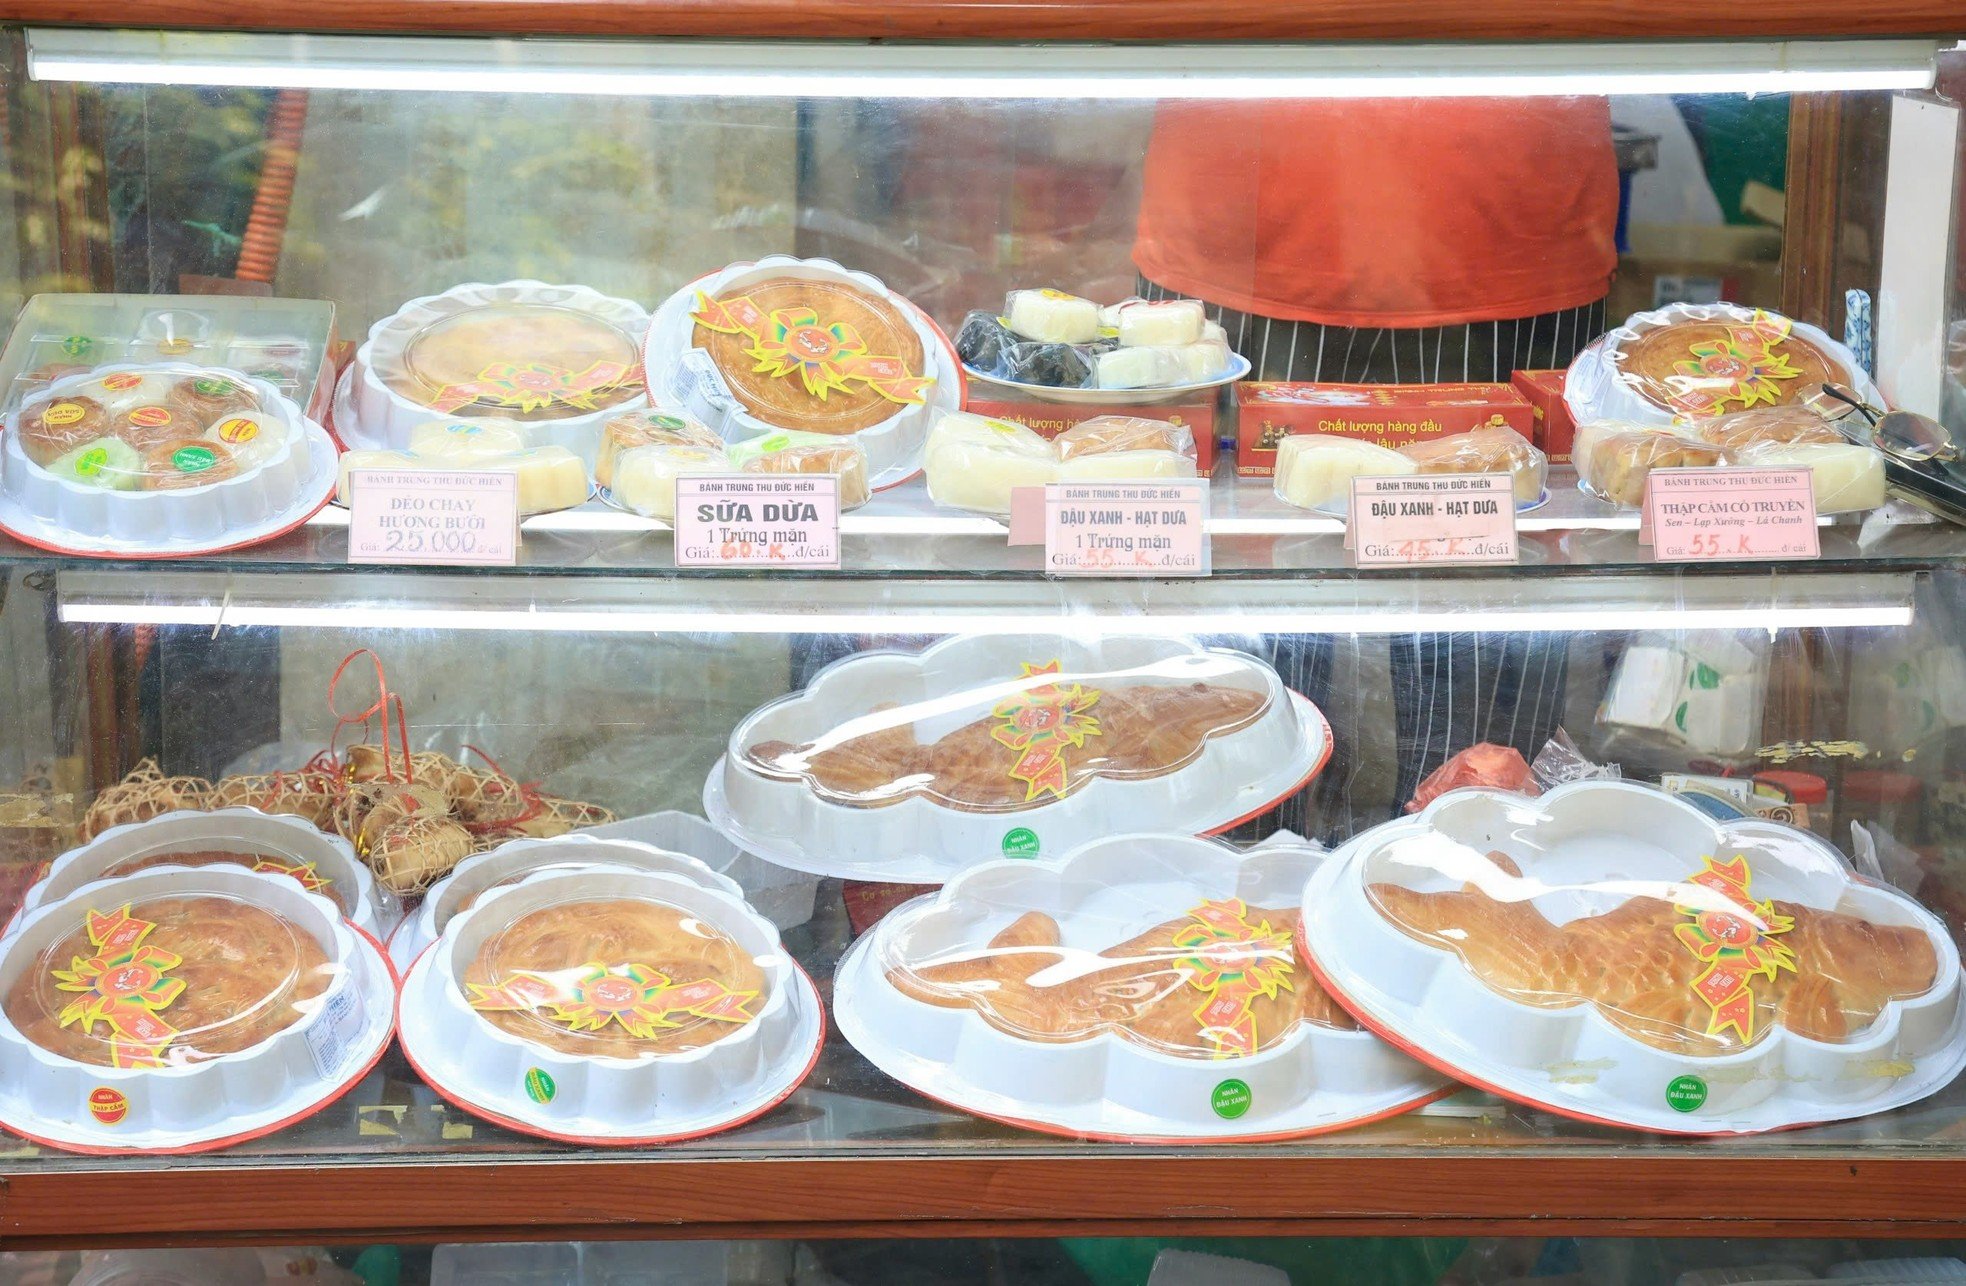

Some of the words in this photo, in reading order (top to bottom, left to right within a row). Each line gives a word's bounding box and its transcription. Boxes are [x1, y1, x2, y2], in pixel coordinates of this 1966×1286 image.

[1318, 417, 1346, 432] Chất
[1350, 420, 1384, 434] lượng
[1388, 420, 1417, 434] hàng
[1420, 418, 1442, 432] đầu
[397, 476, 430, 485] TRUNG
[433, 477, 452, 485] THU
[699, 481, 723, 492] BÁNH
[726, 483, 754, 492] TRUNG
[756, 483, 772, 492] THU
[774, 480, 792, 491] ĐỨC
[1376, 481, 1400, 491] BÁNH
[1402, 481, 1430, 490] TRUNG
[1433, 481, 1448, 490] THU
[1451, 479, 1468, 489] ĐỨC
[1693, 478, 1726, 486] TRUNG
[1729, 477, 1747, 485] THU
[1066, 489, 1089, 498] BÁNH
[1092, 490, 1120, 498] TRUNG
[1123, 490, 1138, 499] THU
[1141, 488, 1158, 499] ĐỨC
[429, 498, 475, 511] CHAY
[697, 499, 753, 523] SỮA
[763, 499, 819, 522] DỪA
[1371, 500, 1396, 519] ĐẬU
[1400, 502, 1434, 516] XANH
[1446, 501, 1469, 518] HẠT
[1473, 499, 1498, 514] DƯA
[1661, 502, 1696, 516] THẬP
[1730, 499, 1750, 513] CỔ
[1751, 498, 1805, 513] TRUYỀN
[379, 514, 440, 529] HƯƠNG
[1061, 508, 1085, 527] ĐẬU
[1089, 511, 1122, 524] XANH
[1135, 511, 1158, 528] HẠT
[1162, 509, 1187, 525] DƯA
[1665, 518, 1683, 527] Sen
[1693, 518, 1711, 528] Lạp
[1756, 516, 1769, 525] Lá
[1771, 515, 1803, 525] Chanh
[707, 529, 713, 543] 1
[719, 527, 768, 546] Trứng
[773, 528, 807, 546] mặn
[1076, 536, 1082, 548] 1
[1087, 533, 1133, 551] Trứng
[1139, 534, 1171, 551] mặn
